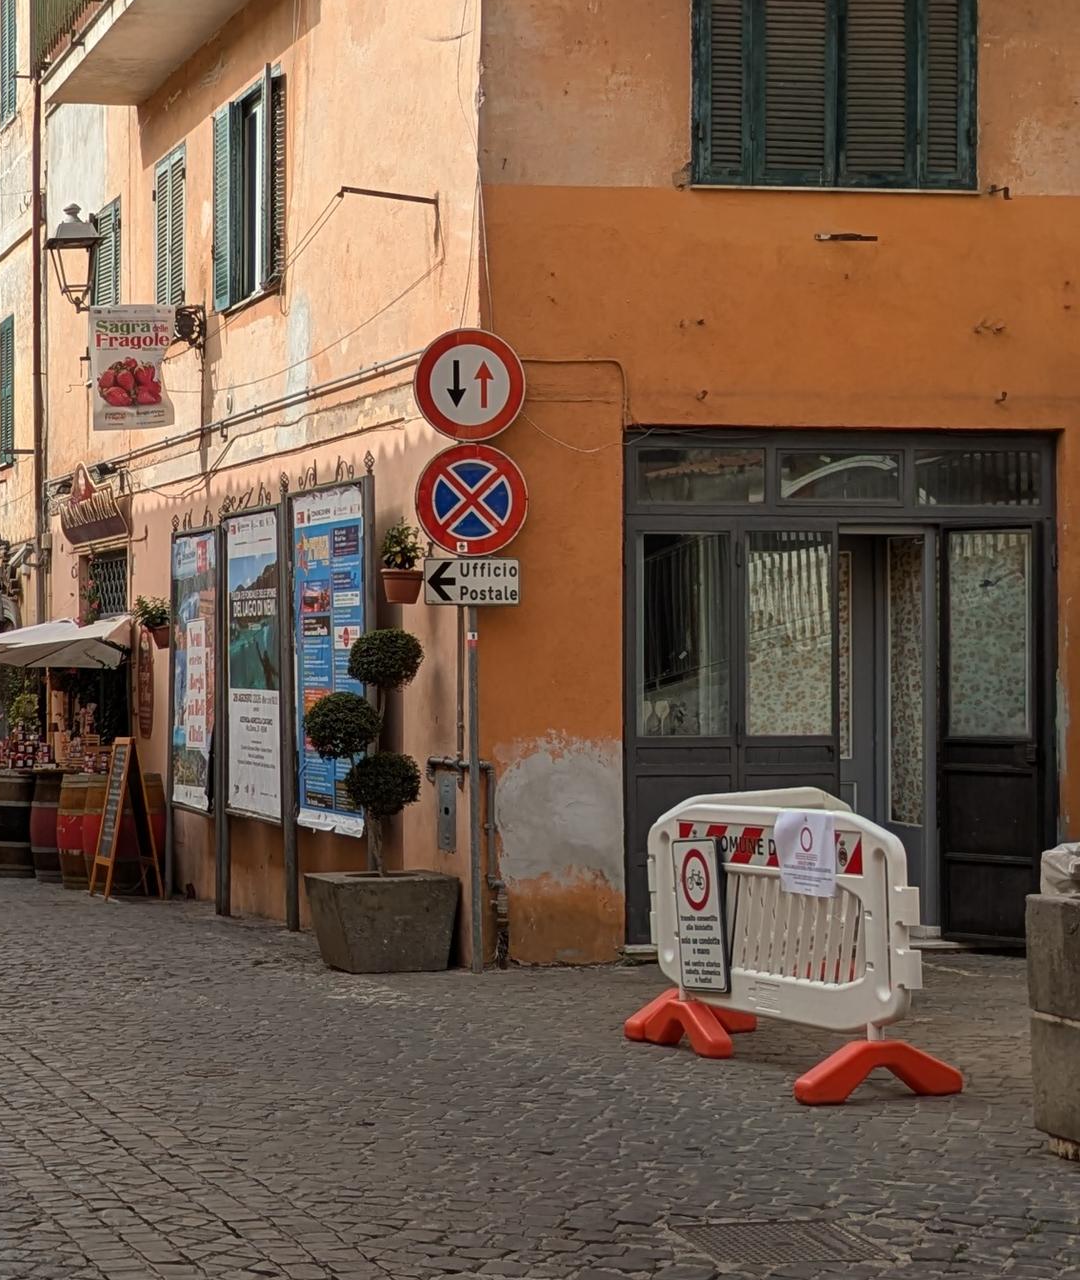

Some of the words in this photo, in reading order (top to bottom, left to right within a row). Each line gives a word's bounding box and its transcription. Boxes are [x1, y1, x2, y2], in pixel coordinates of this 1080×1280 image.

[95, 320, 151, 335] Sagra
[95, 330, 170, 350] Fragole
[460, 563, 518, 578] Ufficio
[460, 586, 518, 601] Postale
[721, 835, 764, 856] OMUNE
